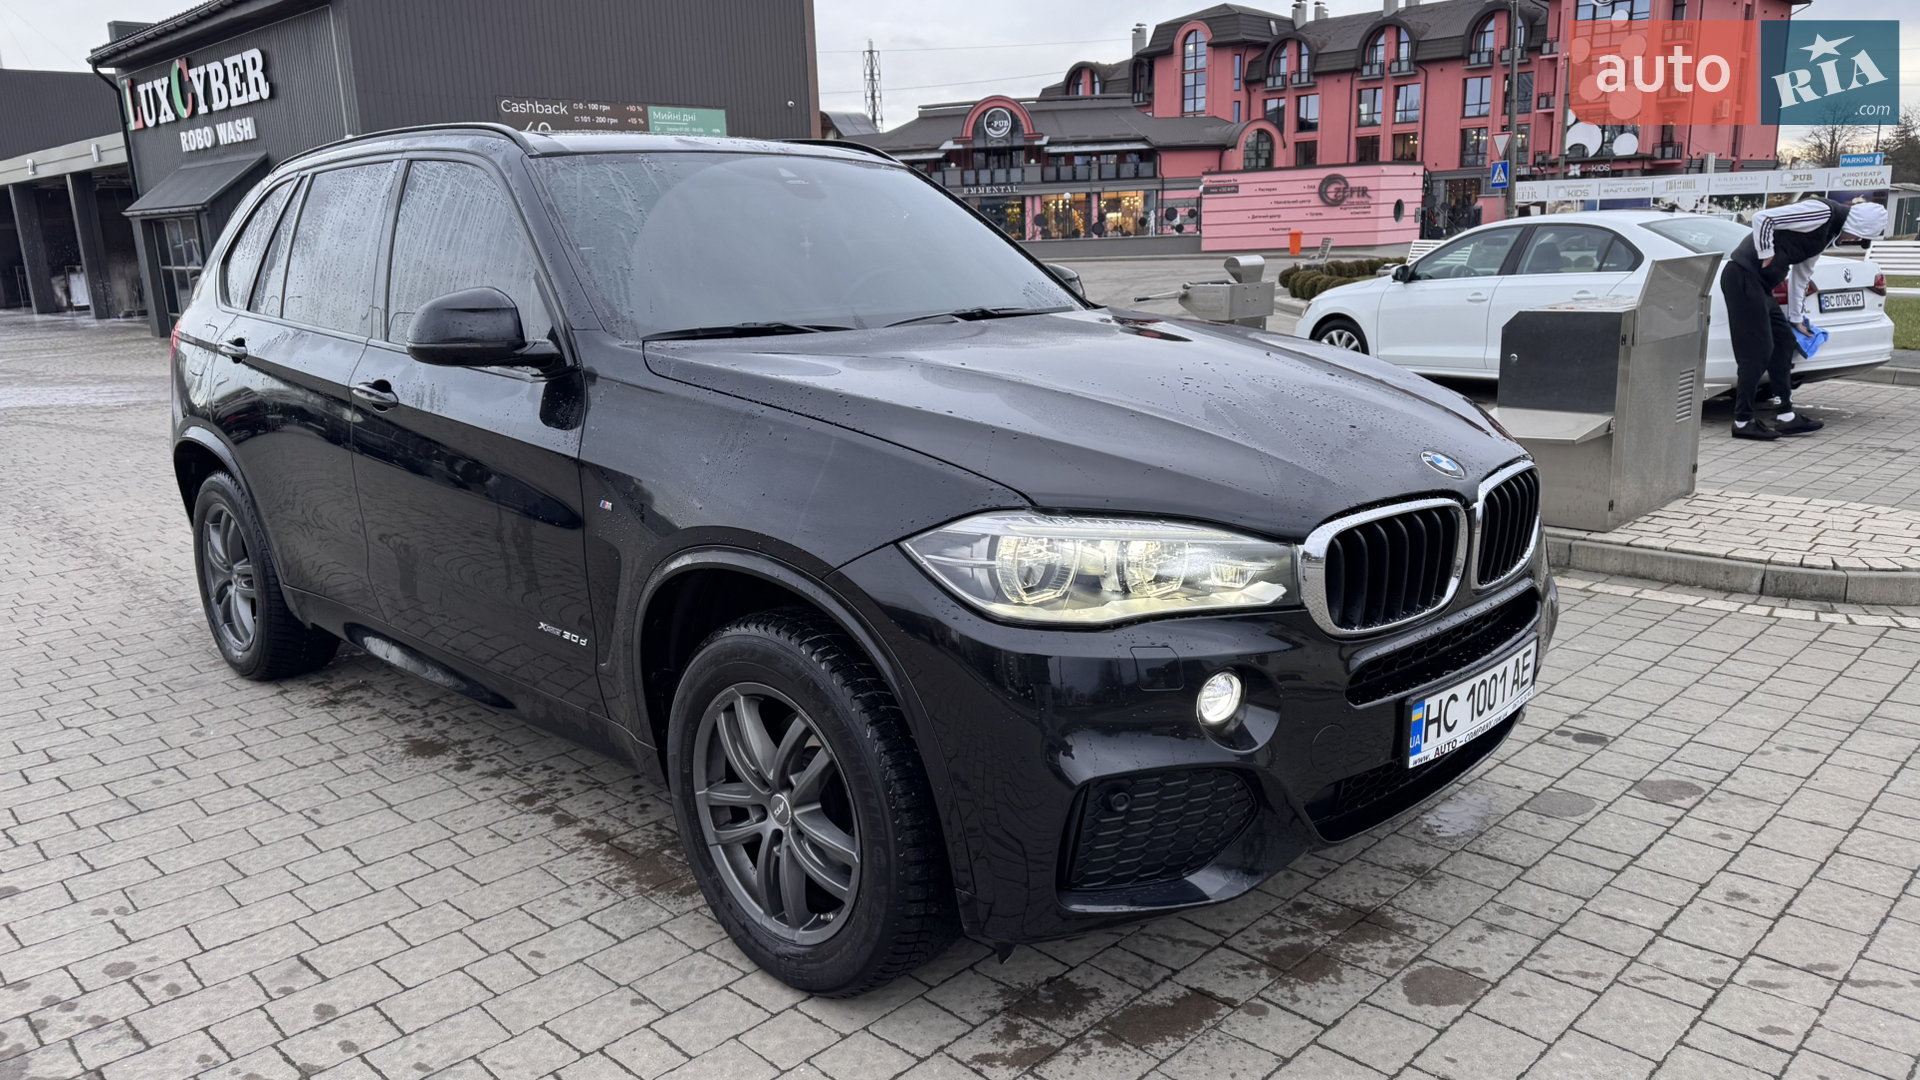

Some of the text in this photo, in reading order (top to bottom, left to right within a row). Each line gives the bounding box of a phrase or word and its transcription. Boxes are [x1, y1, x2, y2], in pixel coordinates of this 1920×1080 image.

[500, 99, 568, 115] Cashback
[653, 111, 696, 122] Мийні дні
[179, 116, 258, 152] ROBO WASH
[1841, 156, 1874, 164] PARKING
[1793, 173, 1813, 181] PUB
[1843, 178, 1886, 187] CINEMA
[963, 185, 1019, 195] EMMENTAL
[1334, 186, 1372, 200] ZEFIR
[1516, 190, 1538, 200] EFIR
[1567, 189, 1589, 197] KIDS
[1824, 292, 1861, 307] BC 0706 KP
[1423, 693, 1459, 743] HC
[1466, 666, 1508, 722] 1001
[1510, 648, 1533, 698] AE
[1409, 734, 1421, 749] UA
[1434, 739, 1458, 758] AUTO
